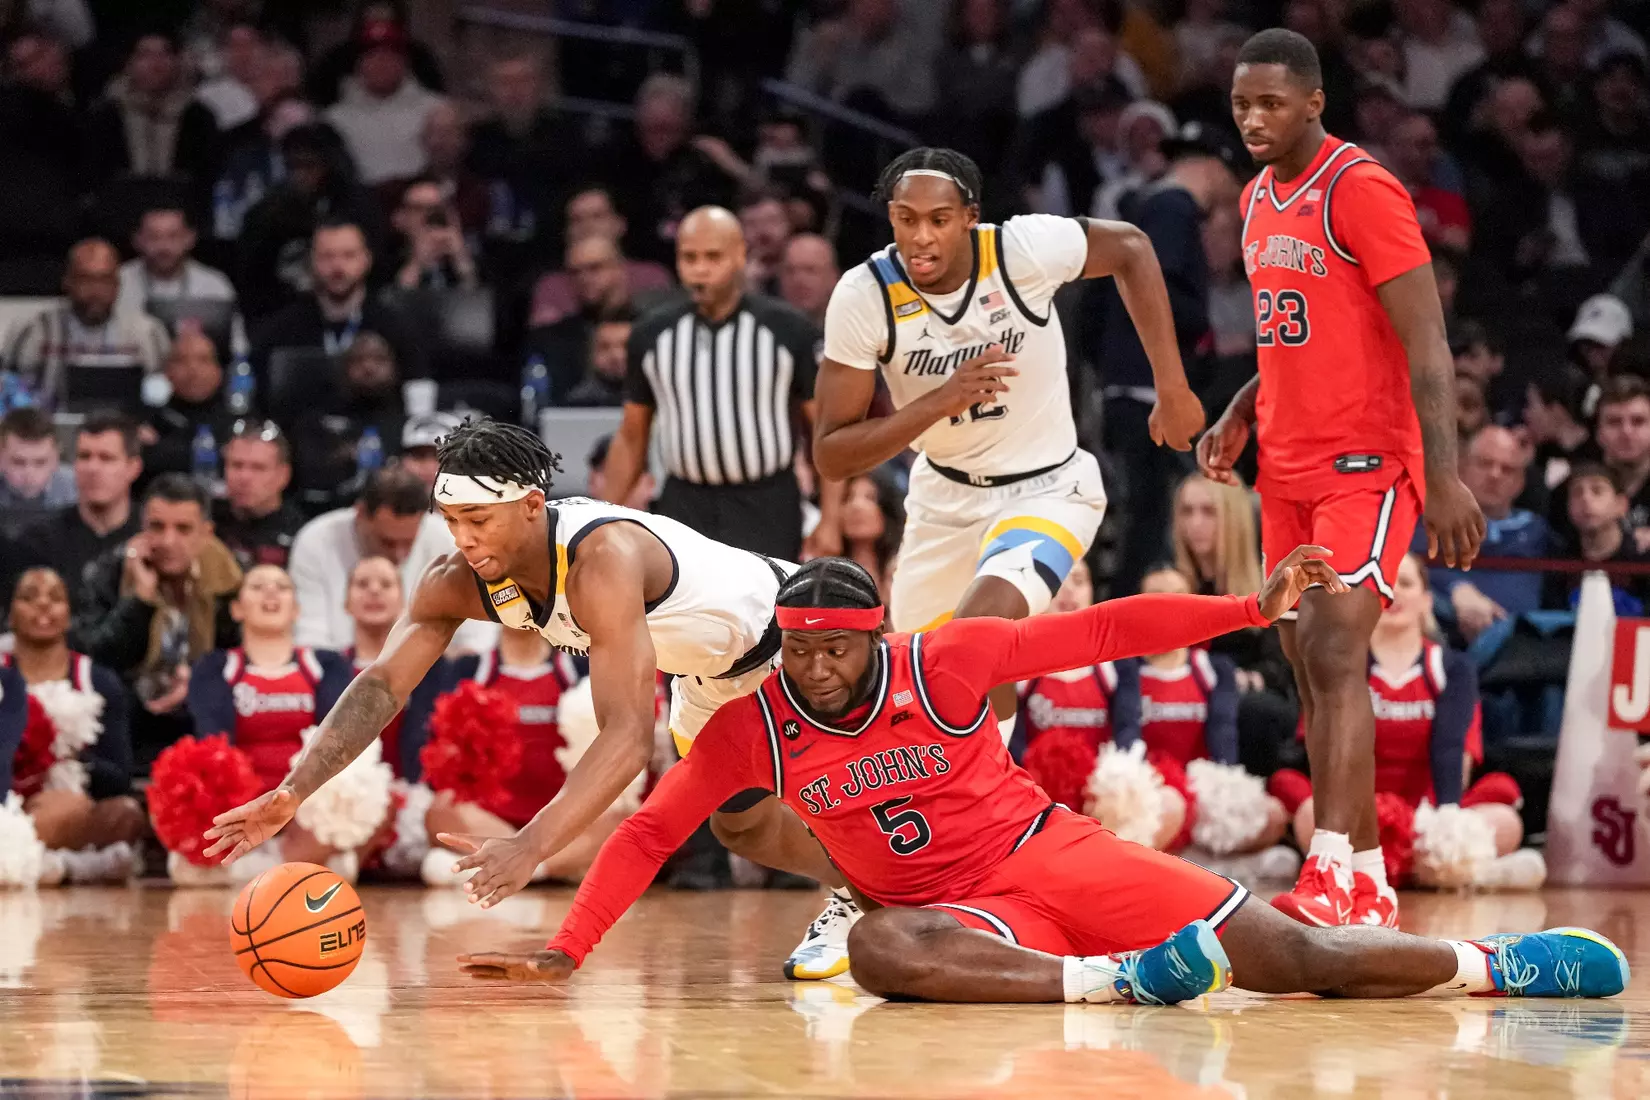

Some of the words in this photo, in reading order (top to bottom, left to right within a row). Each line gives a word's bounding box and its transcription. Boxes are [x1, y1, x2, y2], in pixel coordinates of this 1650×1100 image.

[1256, 288, 1311, 347] 23
[784, 723, 799, 736] JK
[799, 774, 841, 814] ST.
[841, 744, 950, 797] JOHN'S
[869, 794, 932, 856] 5
[320, 918, 366, 952] ELITE
